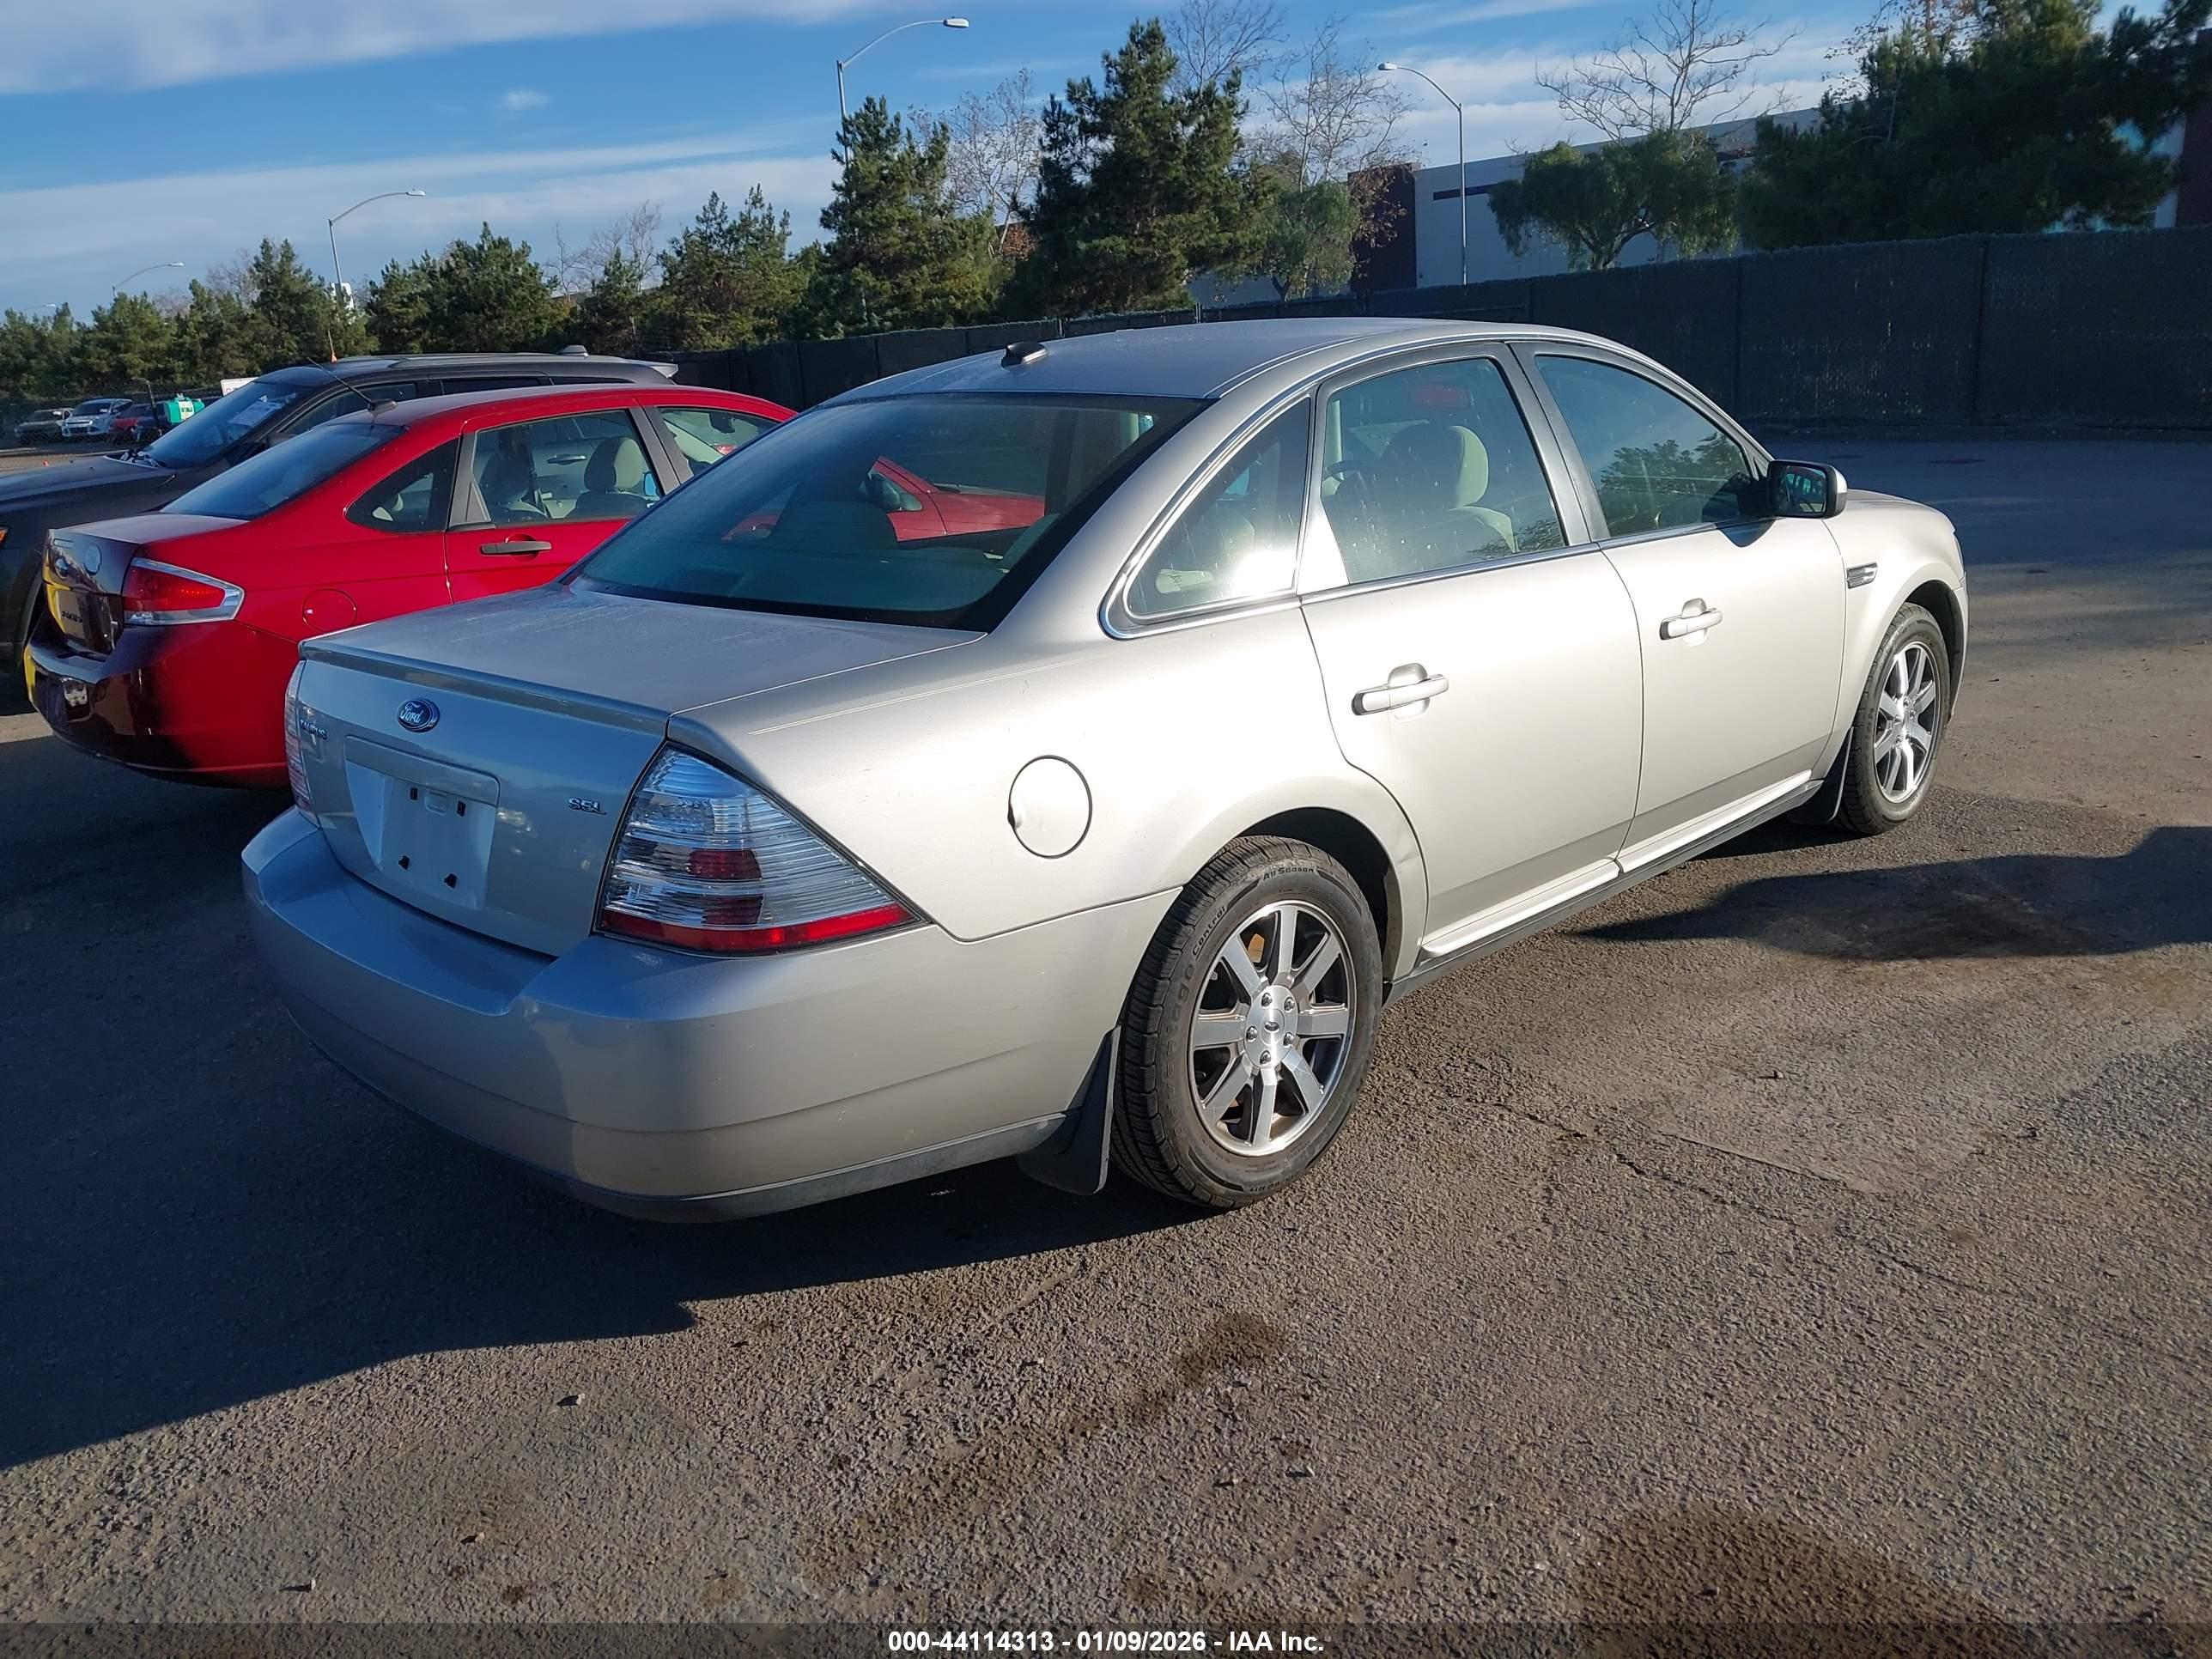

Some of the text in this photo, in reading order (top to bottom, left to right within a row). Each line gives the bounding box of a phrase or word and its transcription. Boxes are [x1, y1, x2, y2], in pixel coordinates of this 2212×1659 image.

[400, 702, 424, 723] Ford
[568, 798, 606, 816] SEL
[1192, 906, 1226, 957] Control
[1278, 866, 1315, 875] Season
